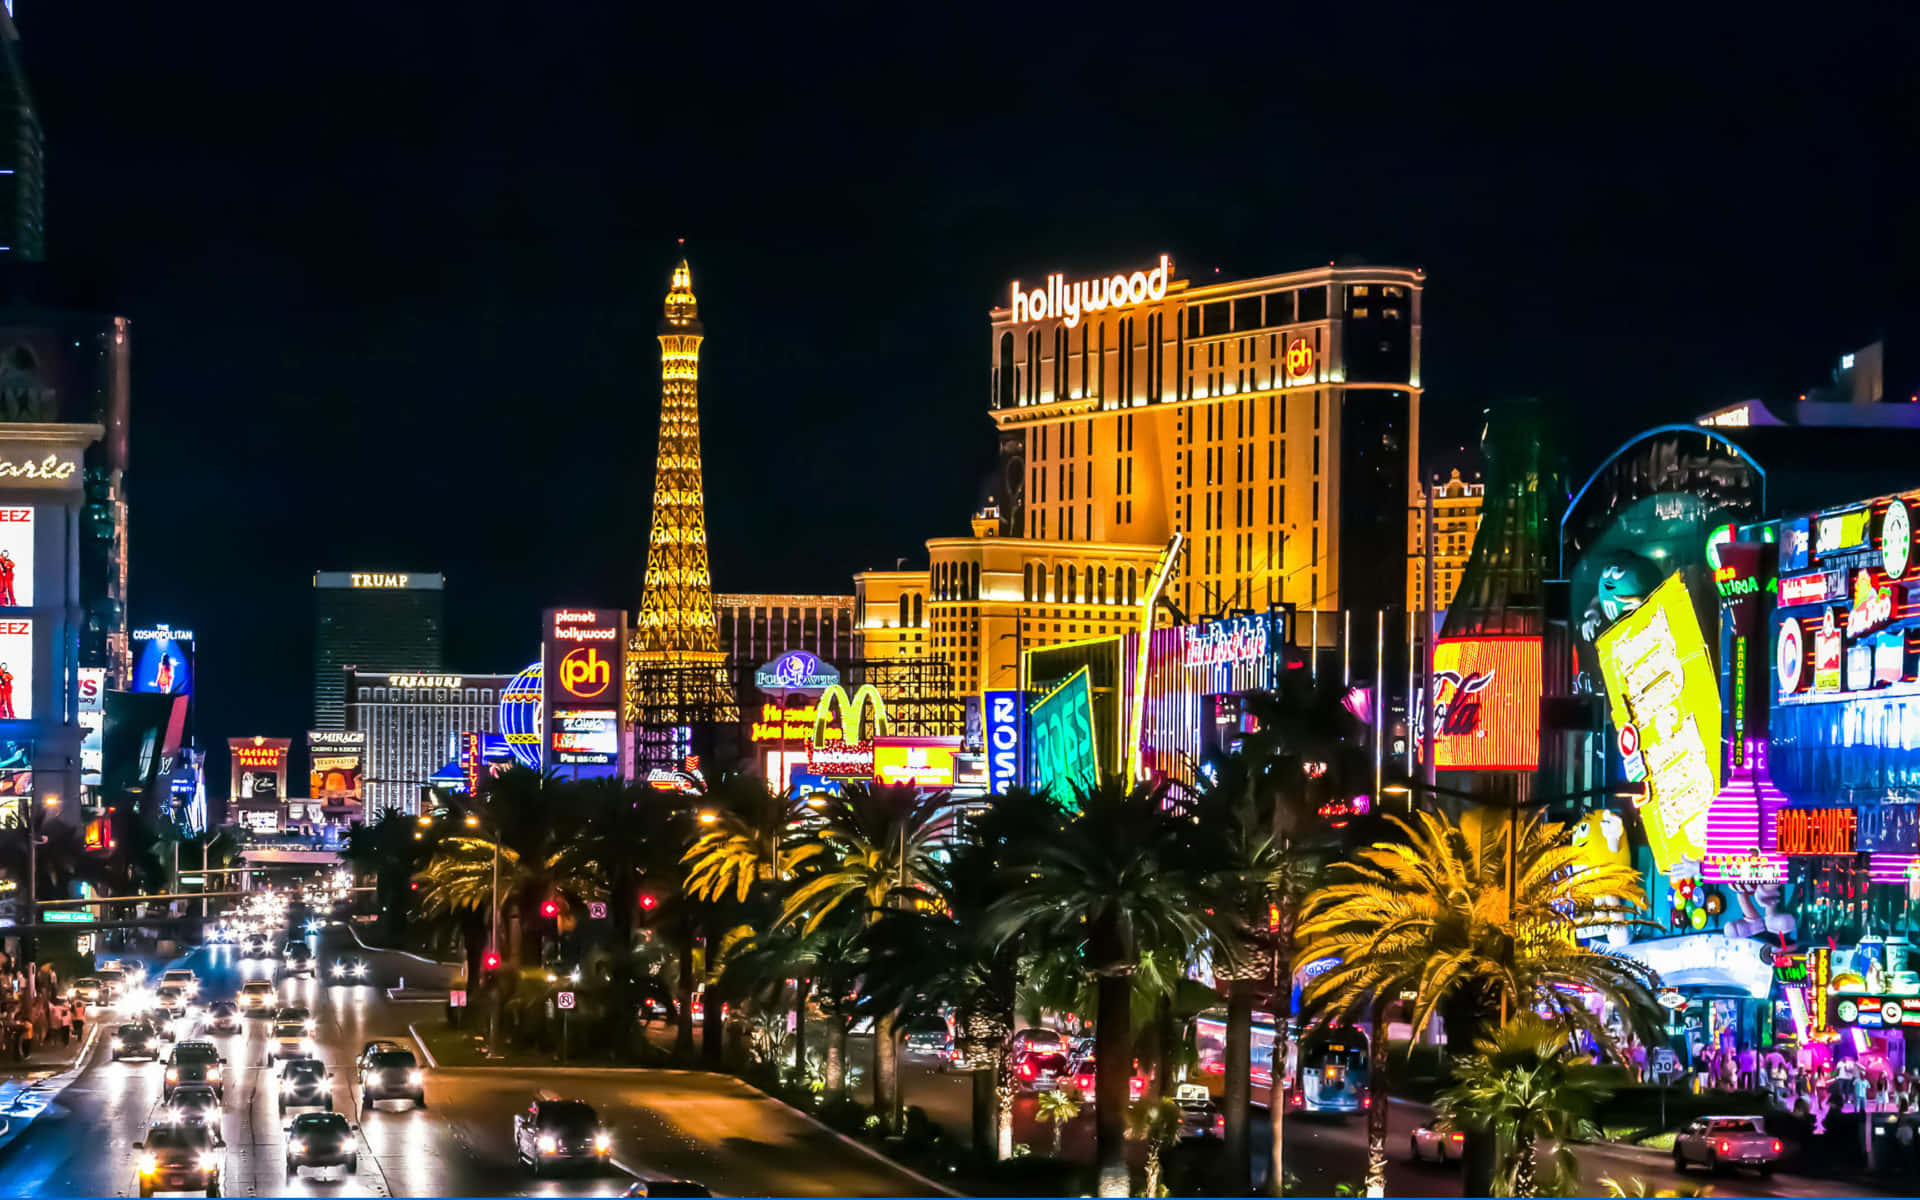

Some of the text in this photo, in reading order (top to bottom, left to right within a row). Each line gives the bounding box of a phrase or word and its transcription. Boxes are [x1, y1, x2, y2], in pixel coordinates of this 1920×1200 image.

[1012, 255, 1169, 328] hollywood
[0, 452, 76, 479] arlo
[352, 573, 408, 588] TRUMP
[555, 610, 596, 625] planet
[133, 630, 193, 641] COSMOPOLITAN
[554, 626, 617, 642] hollywood
[566, 647, 611, 690] ph
[389, 674, 462, 688] TREASURE
[238, 748, 280, 758] CAESARS
[239, 758, 280, 767] PALACE
[1776, 808, 1854, 852] FOOD COURT
